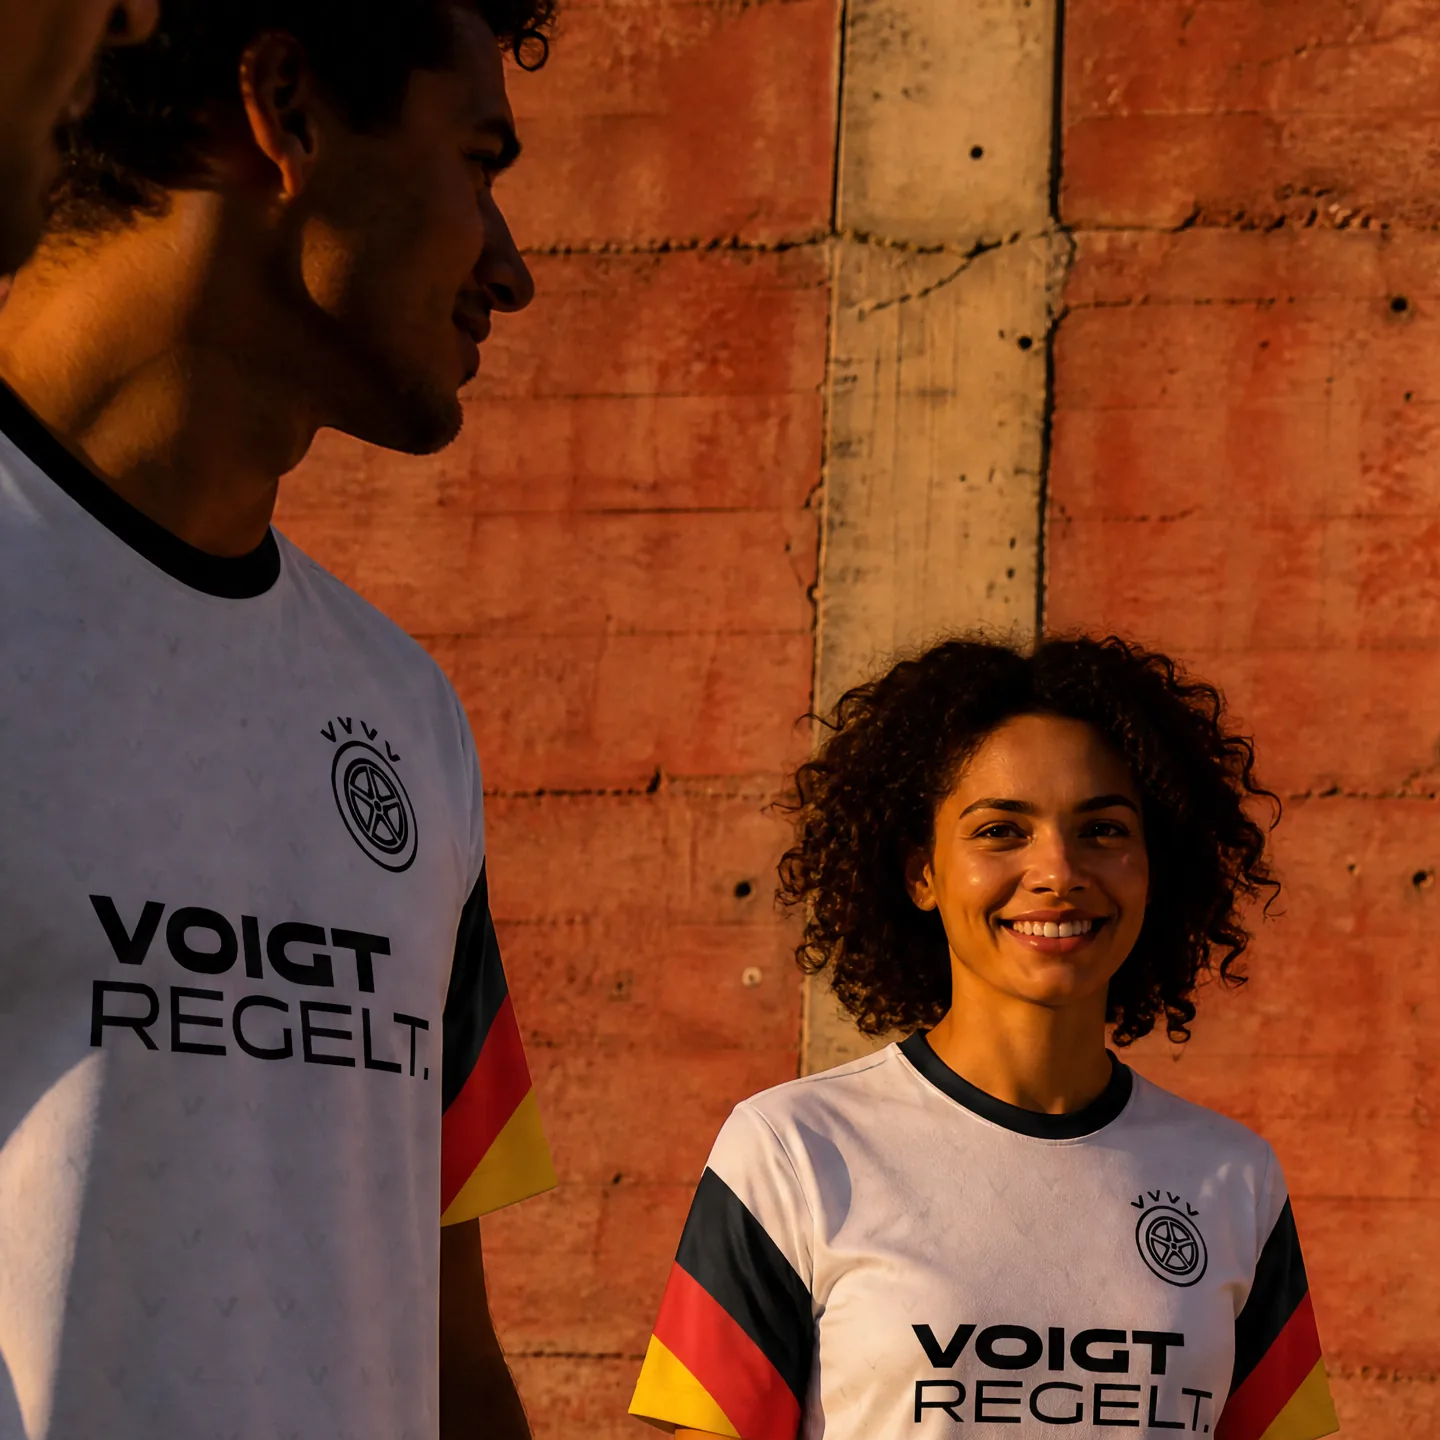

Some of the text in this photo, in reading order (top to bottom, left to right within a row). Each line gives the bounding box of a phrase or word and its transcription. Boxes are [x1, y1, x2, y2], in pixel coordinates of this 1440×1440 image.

[89, 894, 391, 993] VOIGT
[90, 980, 430, 1080] REGELT.
[912, 1324, 1184, 1375] VOIGT
[914, 1380, 1212, 1433] REGELT.
